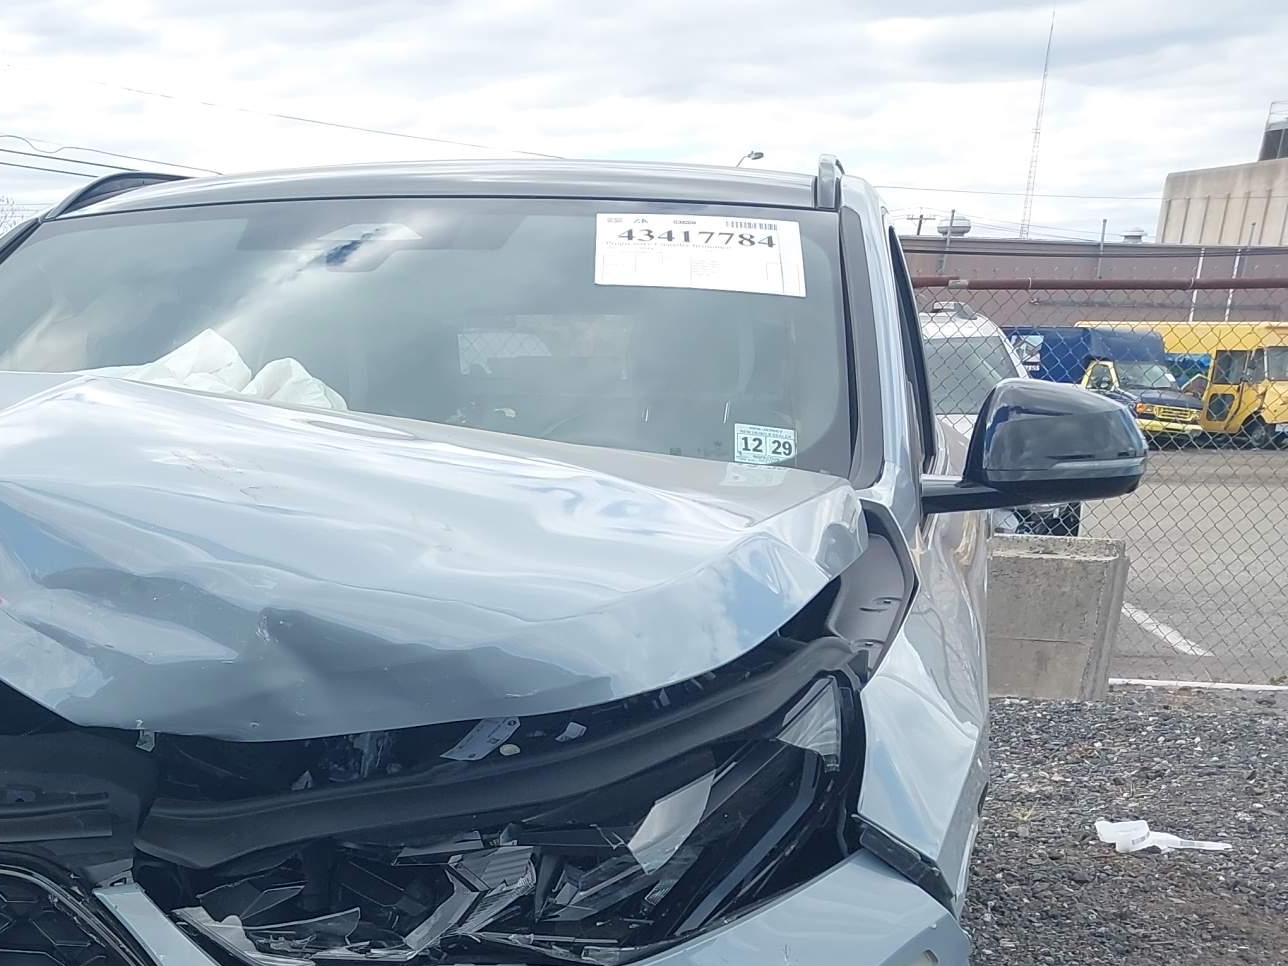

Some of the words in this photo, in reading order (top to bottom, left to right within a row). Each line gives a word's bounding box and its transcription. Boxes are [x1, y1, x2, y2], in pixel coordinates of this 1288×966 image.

[617, 228, 777, 248] 43417784
[741, 436, 763, 453] 12
[771, 439, 793, 457] 29
